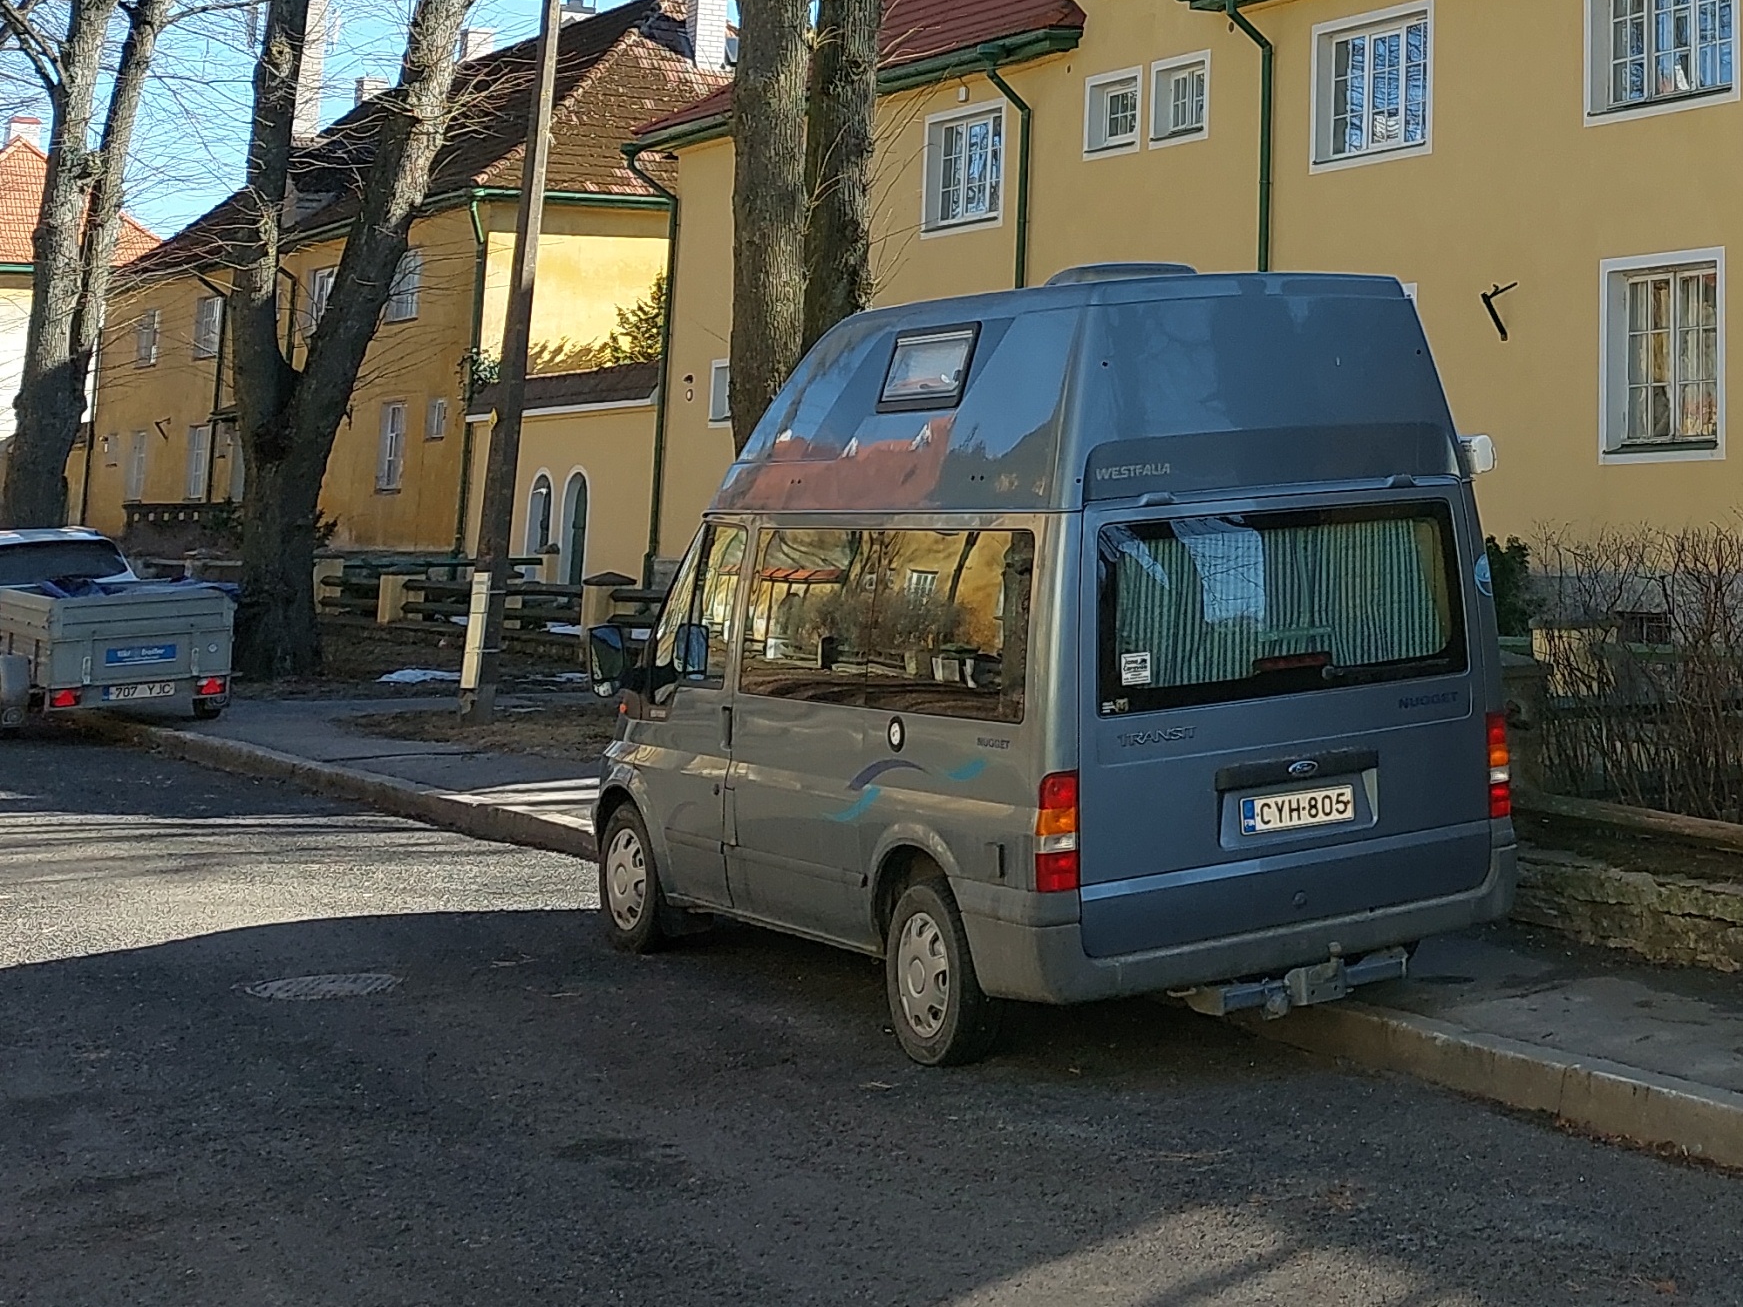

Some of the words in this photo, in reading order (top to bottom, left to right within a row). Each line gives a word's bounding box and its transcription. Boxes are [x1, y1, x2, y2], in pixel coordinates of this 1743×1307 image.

[1095, 463, 1171, 481] WESTFALIA
[115, 686, 138, 699] 707
[147, 683, 172, 696] YJC
[1398, 691, 1459, 709] NUGGET
[1117, 725, 1197, 748] TRANSIT
[1260, 792, 1348, 826] CYH-805
